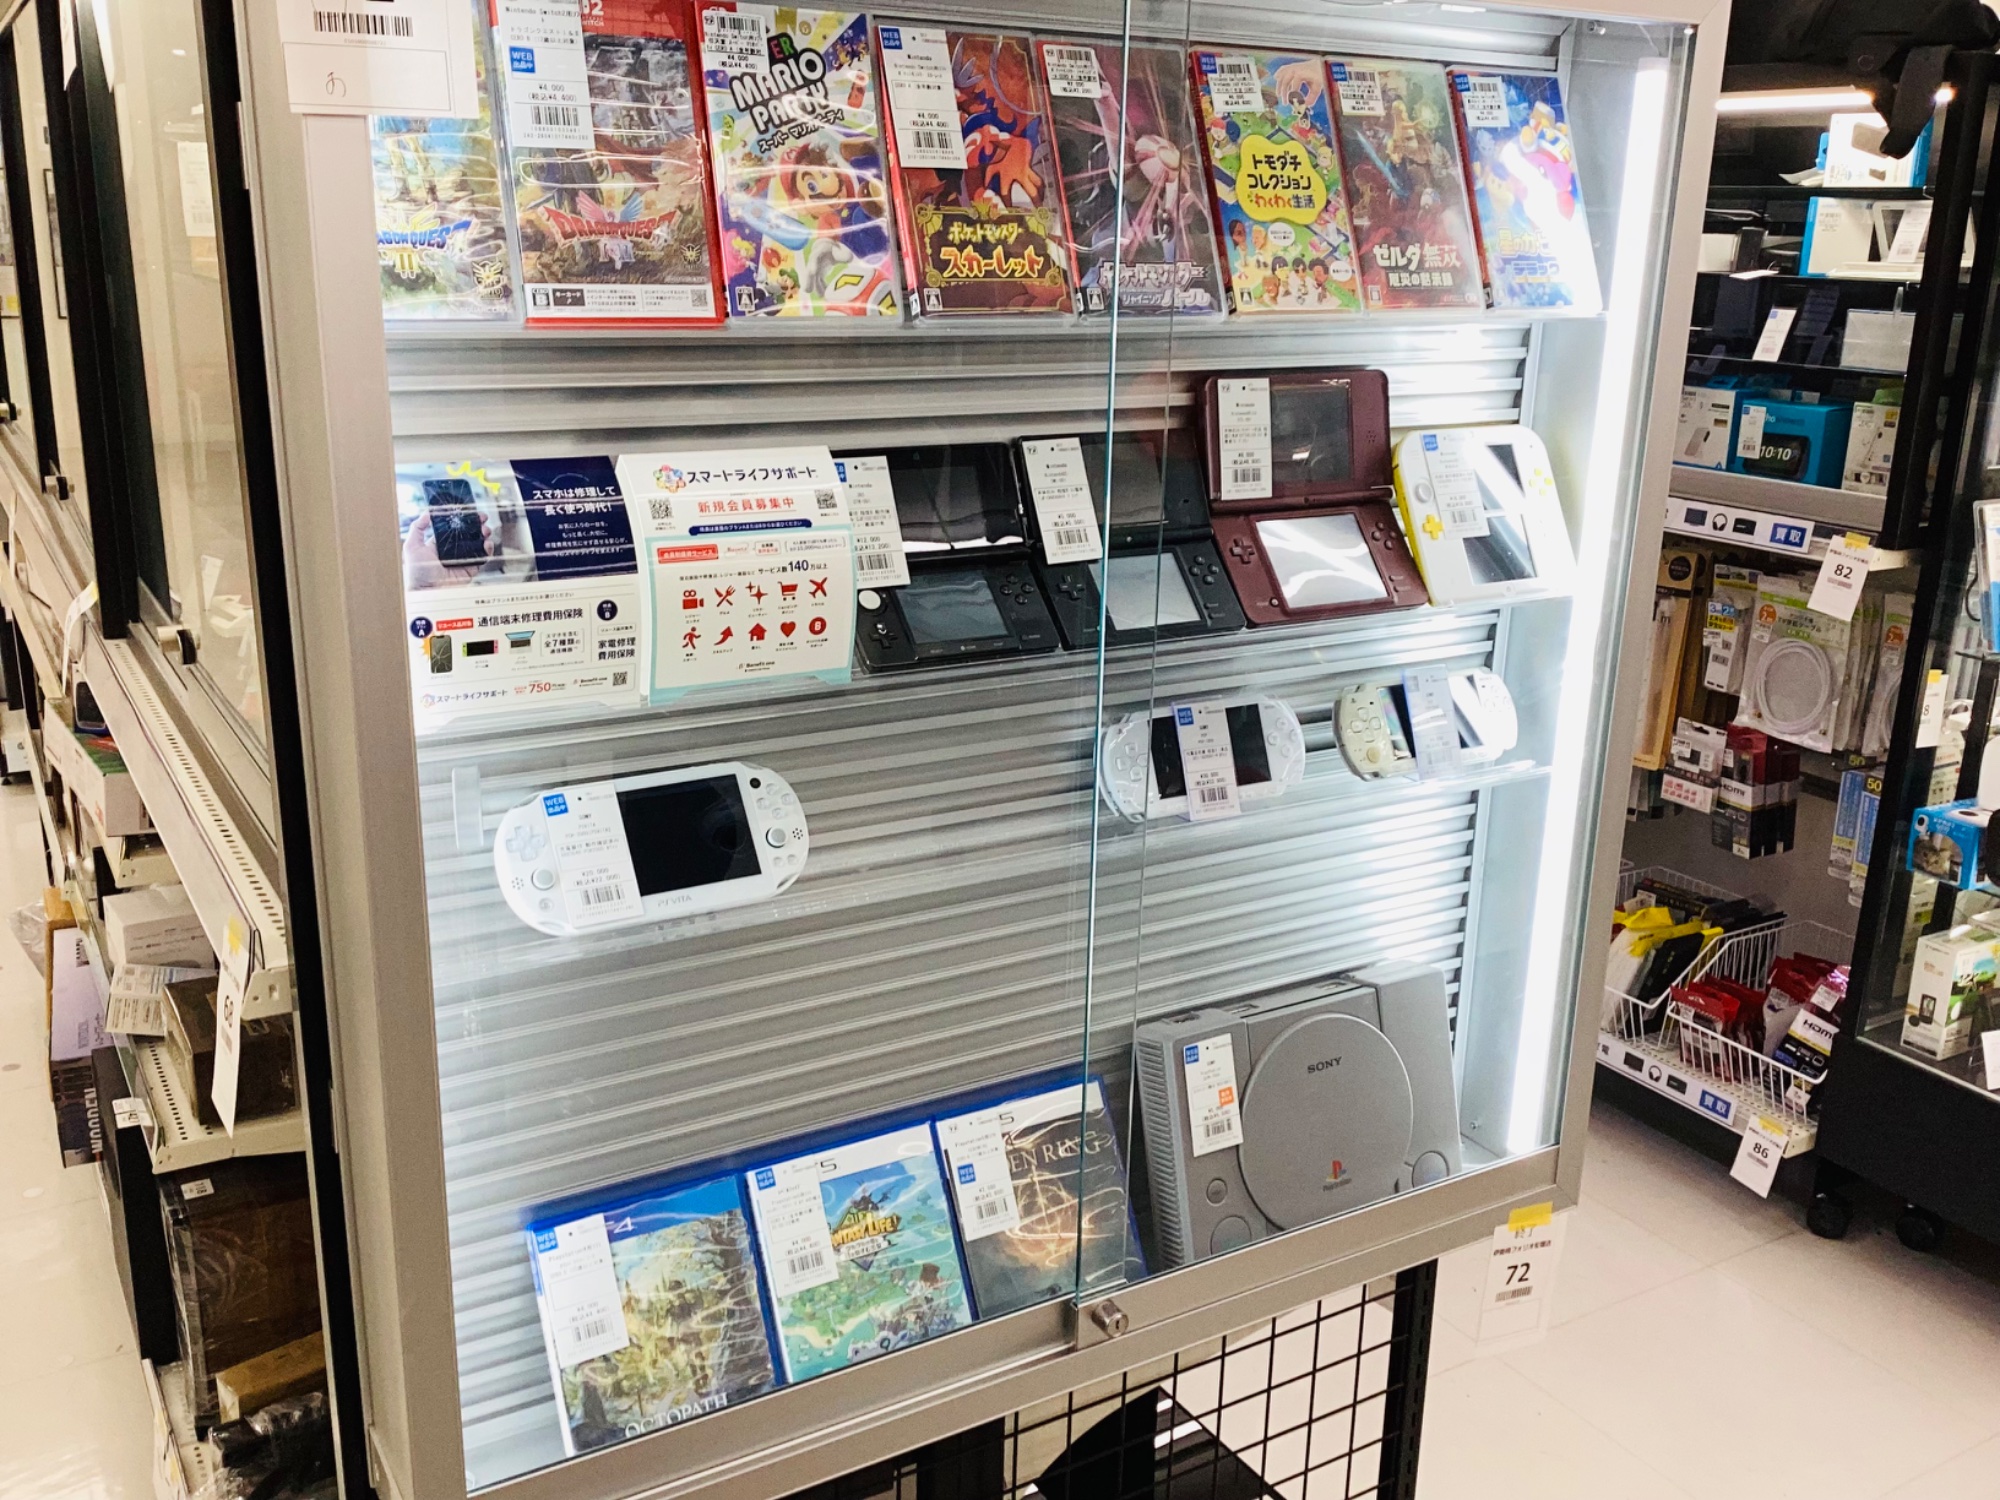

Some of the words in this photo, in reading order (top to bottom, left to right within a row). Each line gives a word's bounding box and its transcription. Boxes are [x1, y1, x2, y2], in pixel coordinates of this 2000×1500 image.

[511, 51, 533, 61] WEB
[731, 49, 824, 111] MARIO
[1252, 150, 1302, 172] トモダチ
[1247, 173, 1312, 190] コレクション
[1254, 194, 1316, 209] わくわく生活
[939, 246, 1045, 279] スカーレット
[1372, 242, 1461, 272] ゼルダ無双
[1760, 445, 1792, 461] 10:10
[687, 466, 818, 484] スマートライフサポート
[532, 485, 617, 500] スマホは修理して
[697, 496, 795, 513] 新規会員募集中
[1773, 527, 1803, 544] 買取
[1833, 563, 1853, 580] 82
[477, 607, 584, 628] 通信端末修理費用保険
[597, 637, 637, 650] 家電修理
[597, 648, 636, 661] 費用保険
[437, 688, 508, 704] スマートライフサポート
[528, 682, 552, 694] 750
[1866, 777, 1882, 792] 50
[1307, 1056, 1343, 1074] SONY
[1703, 1092, 1728, 1115] 買取
[1752, 1141, 1770, 1160] 86
[1505, 1262, 1531, 1286] 72
[624, 1391, 729, 1438] OCTOPATH
